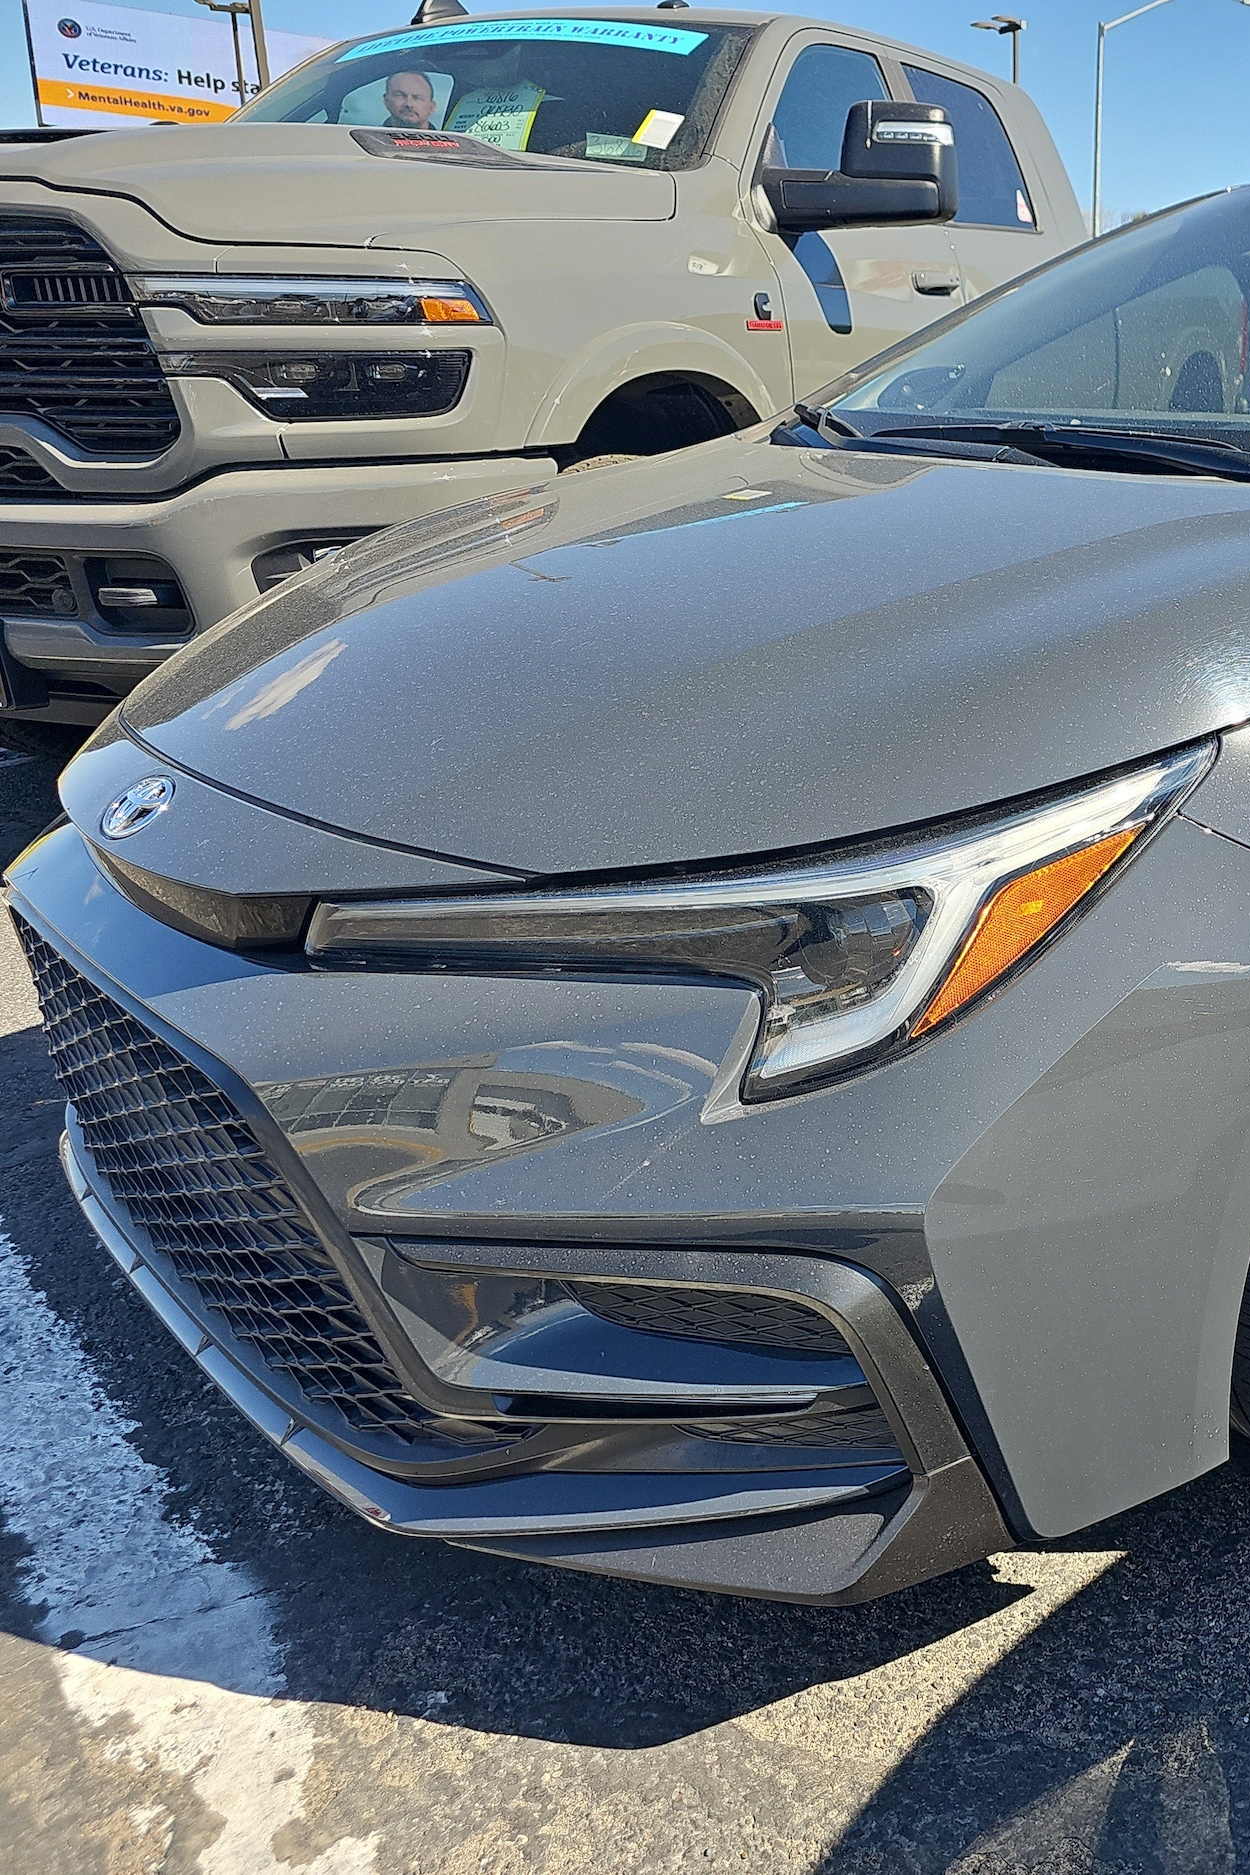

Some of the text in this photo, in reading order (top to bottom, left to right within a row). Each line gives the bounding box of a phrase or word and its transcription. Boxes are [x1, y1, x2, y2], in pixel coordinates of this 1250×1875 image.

[358, 32, 438, 53] LIFETIME
[440, 25, 567, 38] POWERTRAIN
[571, 26, 684, 44] WARRANTY
[62, 53, 169, 83] Veterans:
[177, 69, 226, 94] Help
[77, 90, 211, 117] MentalHealth.va.gov
